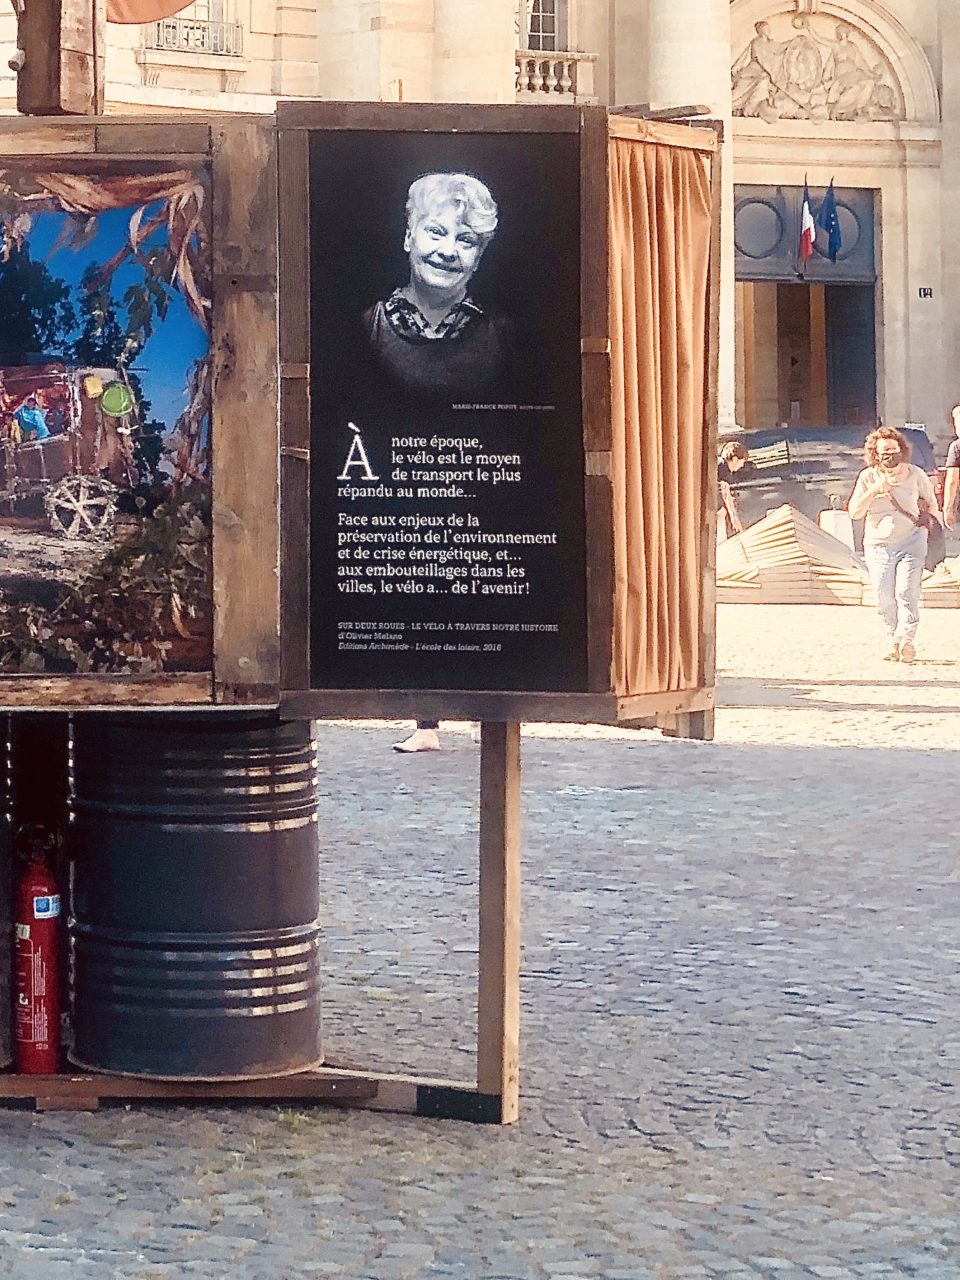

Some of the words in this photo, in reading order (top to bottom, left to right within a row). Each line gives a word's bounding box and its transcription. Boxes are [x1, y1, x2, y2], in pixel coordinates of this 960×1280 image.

[336, 422, 380, 481] À
[391, 437, 427, 448] notre
[429, 434, 483, 451] époque,
[391, 450, 404, 464] le
[406, 450, 435, 464] vélo
[437, 453, 458, 465] est
[460, 450, 473, 465] le
[475, 454, 521, 469] moyen
[391, 468, 408, 481] de
[411, 469, 474, 484] transport
[476, 468, 489, 481] le
[492, 468, 522, 485] plus
[337, 483, 393, 501] répandu
[396, 487, 414, 498] au
[416, 484, 477, 498] monde...
[337, 512, 369, 526] Face
[371, 515, 397, 526] aux
[398, 513, 445, 530] enjeux
[446, 513, 464, 527] de
[467, 513, 480, 527] la
[337, 529, 422, 546] préservation
[423, 530, 440, 544] de
[443, 529, 558, 545] l'environnement
[337, 549, 351, 560] et
[353, 546, 370, 560] de
[373, 547, 406, 560] crise
[408, 547, 492, 564] énergétique,
[495, 549, 522, 561] et...
[337, 565, 363, 576] aux
[365, 563, 468, 580] embouteillages
[470, 563, 503, 577] dans
[506, 564, 526, 578] les
[337, 580, 377, 596] villes,
[380, 580, 393, 594] le
[395, 580, 424, 594] vélo
[426, 583, 448, 594] a...
[451, 581, 468, 595] de
[337, 622, 354, 630] SUR
[355, 622, 377, 630] DEUX
[378, 622, 405, 630] ROUES
[411, 622, 422, 631] LE
[455, 623, 490, 631] TRAVERS
[492, 623, 520, 632] NOTRE
